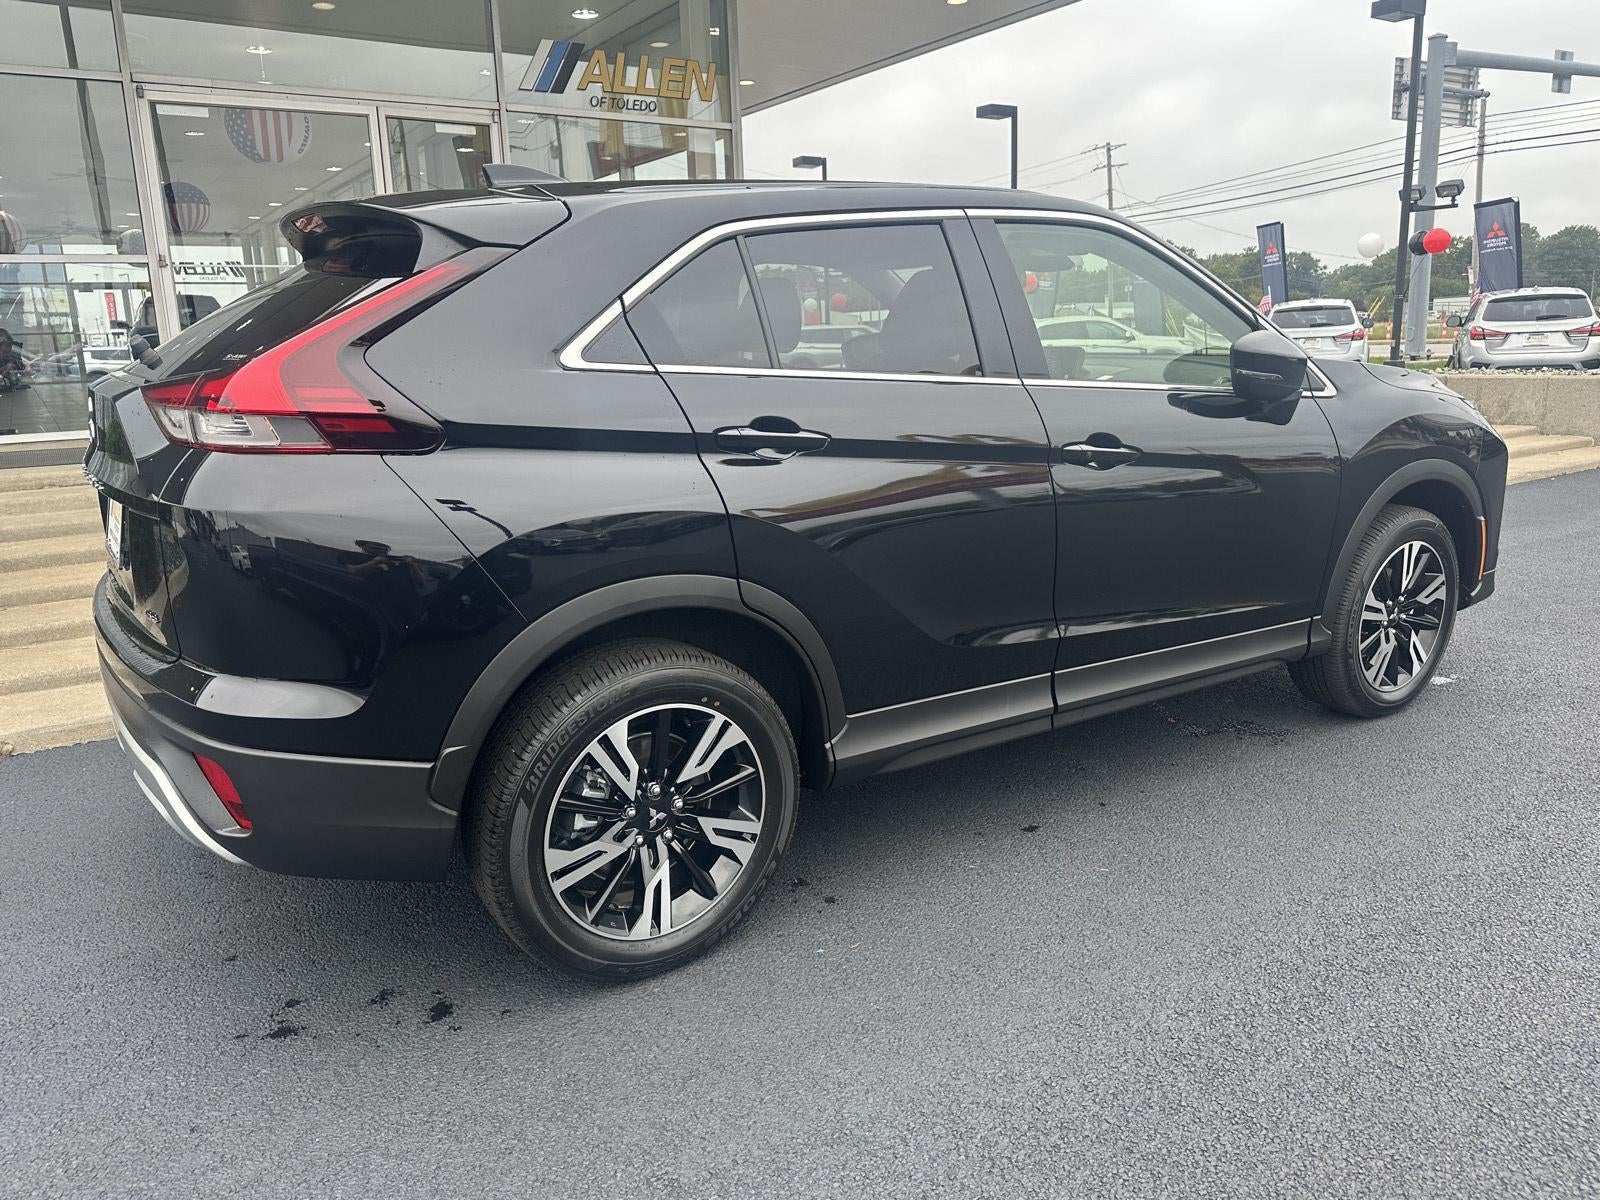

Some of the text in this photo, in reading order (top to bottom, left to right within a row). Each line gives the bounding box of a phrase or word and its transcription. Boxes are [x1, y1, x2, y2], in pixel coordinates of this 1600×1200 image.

[577, 50, 717, 102] ALLEN
[590, 95, 658, 113] OF TOLEDO
